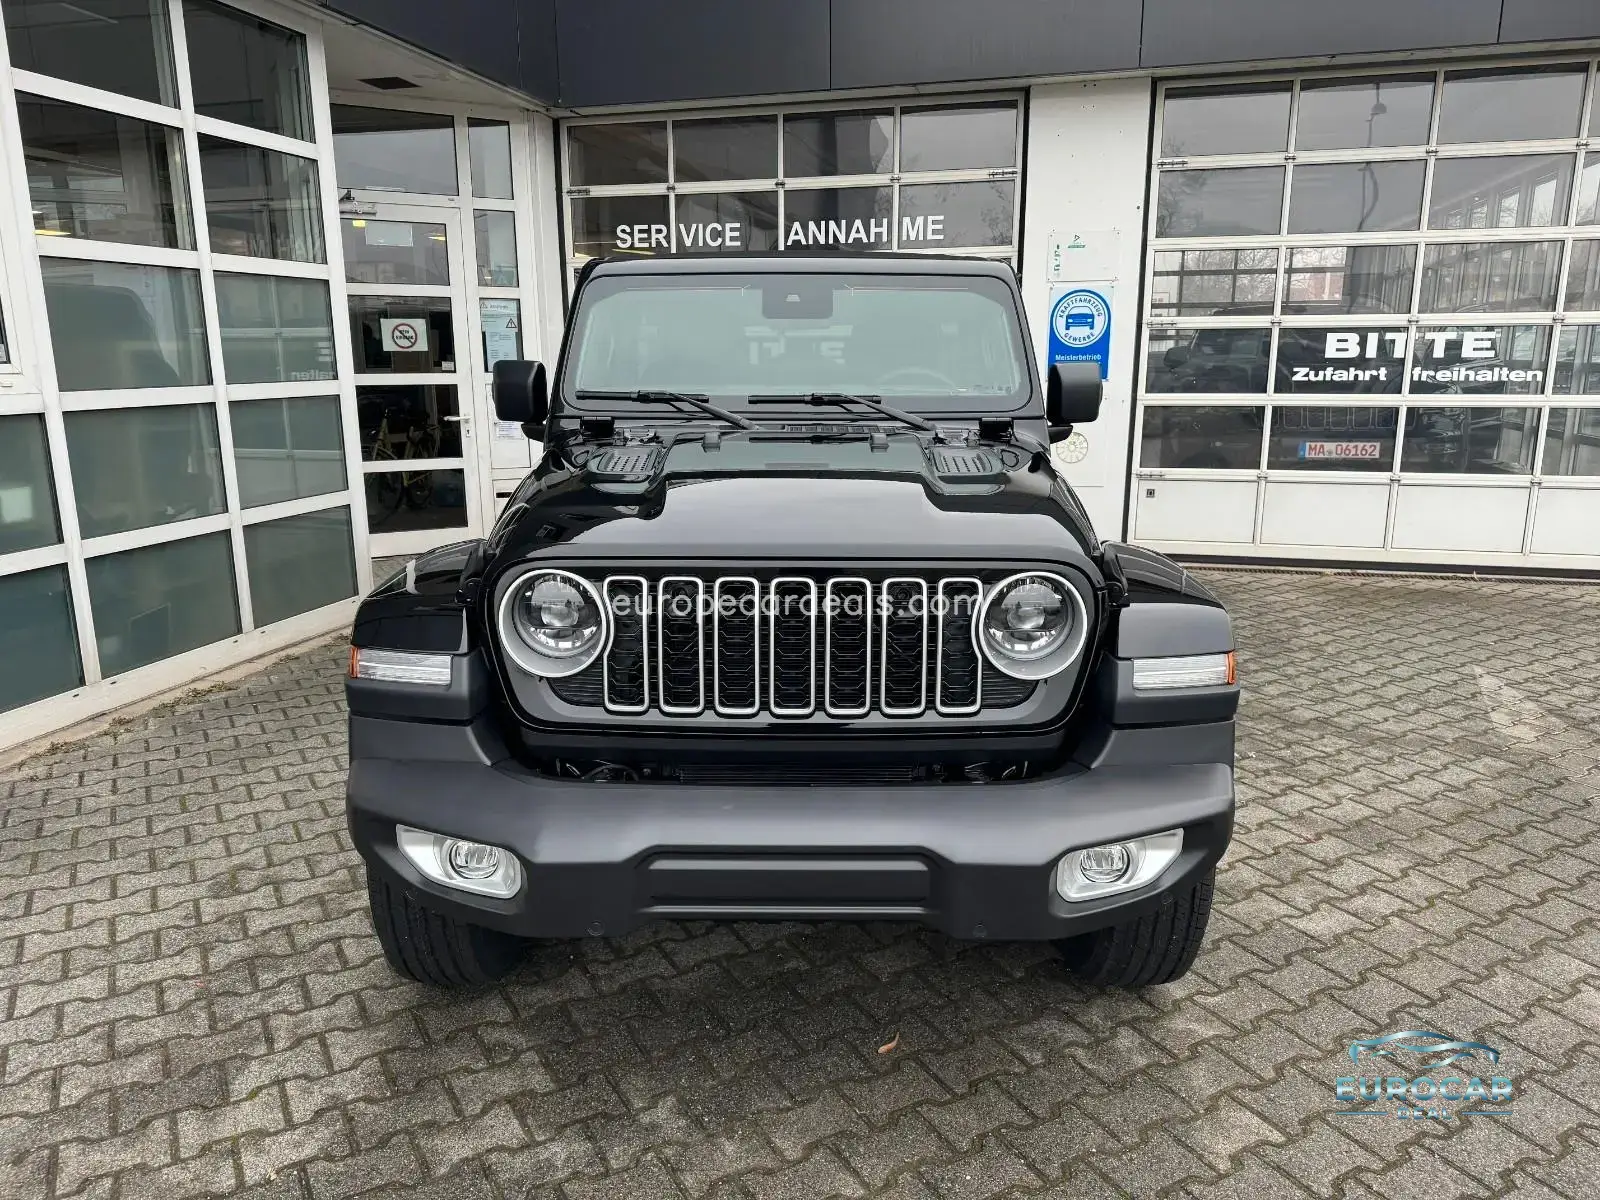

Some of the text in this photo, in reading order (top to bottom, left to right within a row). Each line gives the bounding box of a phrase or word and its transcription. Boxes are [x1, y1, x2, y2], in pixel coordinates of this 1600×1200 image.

[1058, 297, 1103, 319] KRAFTFAHRZEUG
[1063, 332, 1096, 343] GEWERBE
[1324, 332, 1498, 359] BITTE
[1055, 353, 1102, 361] Meisterbetrieb
[1292, 366, 1544, 382] Zufahrt freihalten
